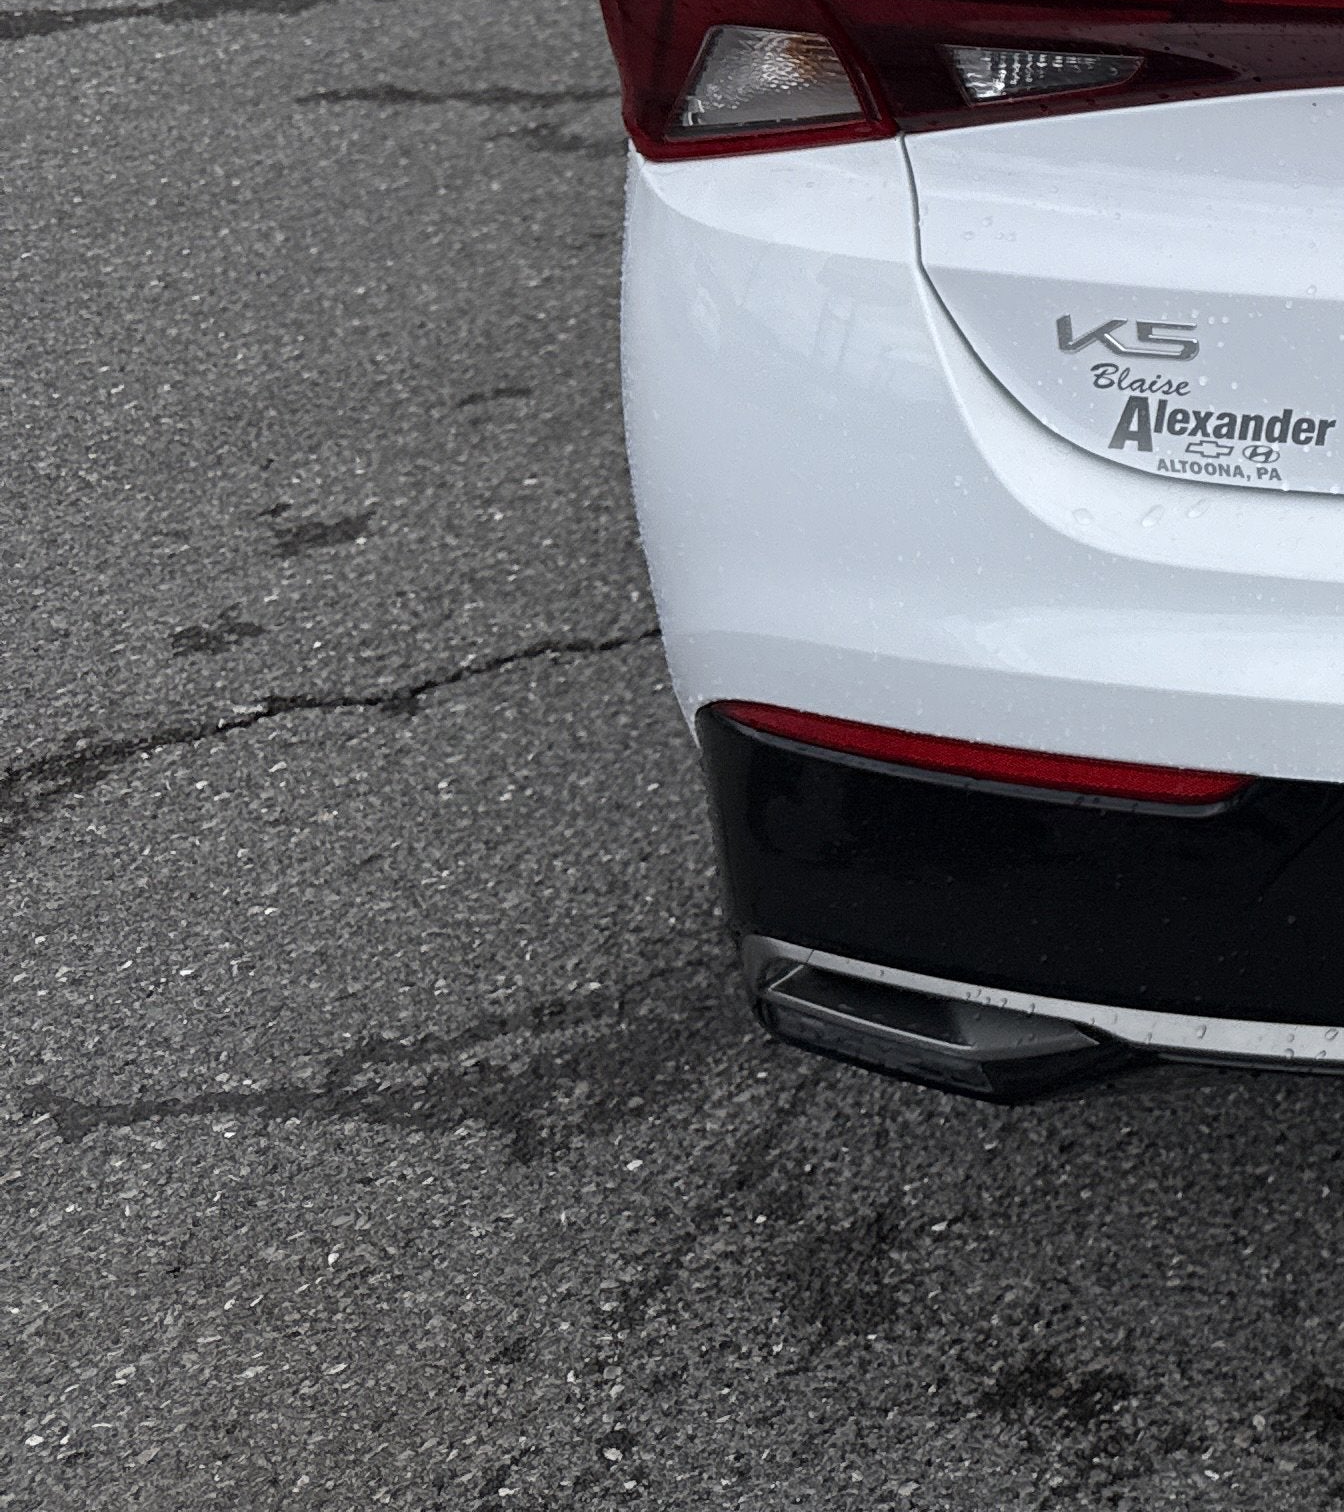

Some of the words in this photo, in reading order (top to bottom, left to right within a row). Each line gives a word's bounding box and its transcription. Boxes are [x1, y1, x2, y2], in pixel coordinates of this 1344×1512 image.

[1056, 313, 1200, 361] K5
[1089, 362, 1191, 397] Blaise
[1107, 395, 1337, 453] Alexander
[1157, 457, 1252, 481] ALTOONA,
[1256, 466, 1282, 481] PA
